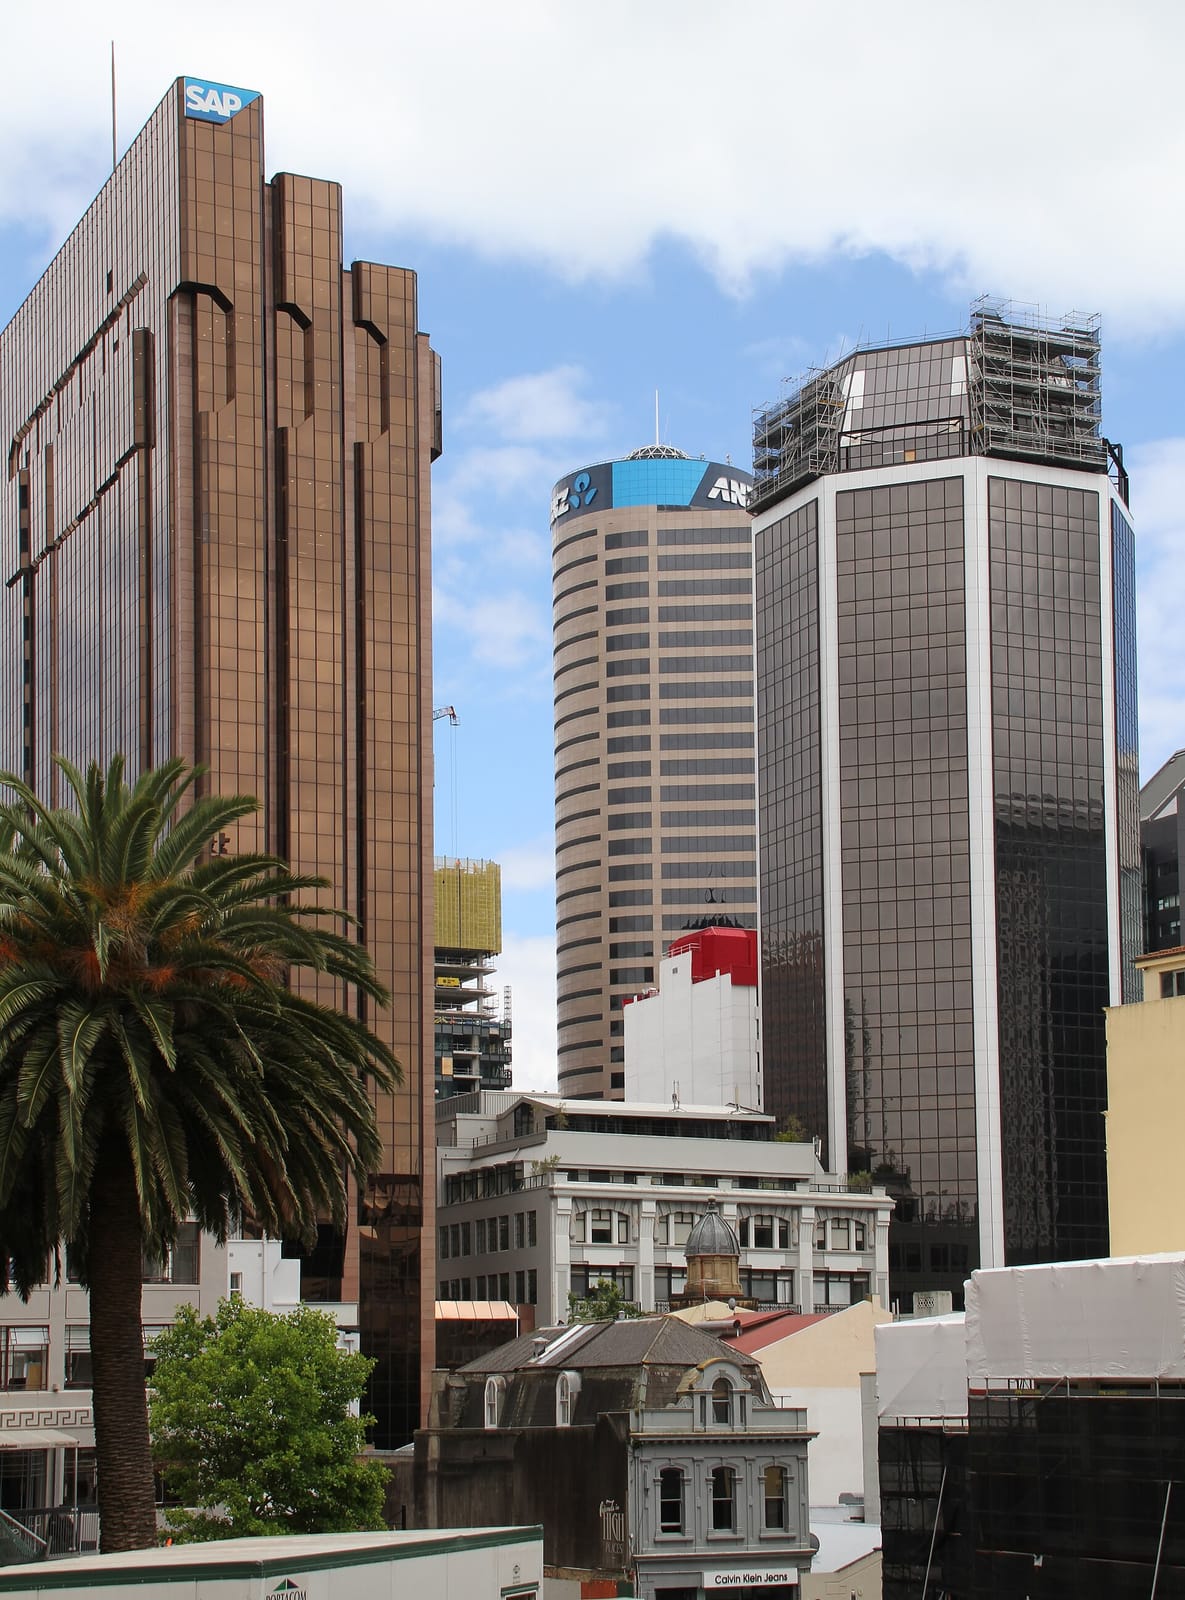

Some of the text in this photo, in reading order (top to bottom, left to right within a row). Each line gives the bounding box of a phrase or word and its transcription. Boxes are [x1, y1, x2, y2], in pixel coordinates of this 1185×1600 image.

[186, 85, 242, 117] SAP
[603, 1513, 624, 1541] HIGH
[715, 1573, 788, 1584] Calvin Klein Jeans
